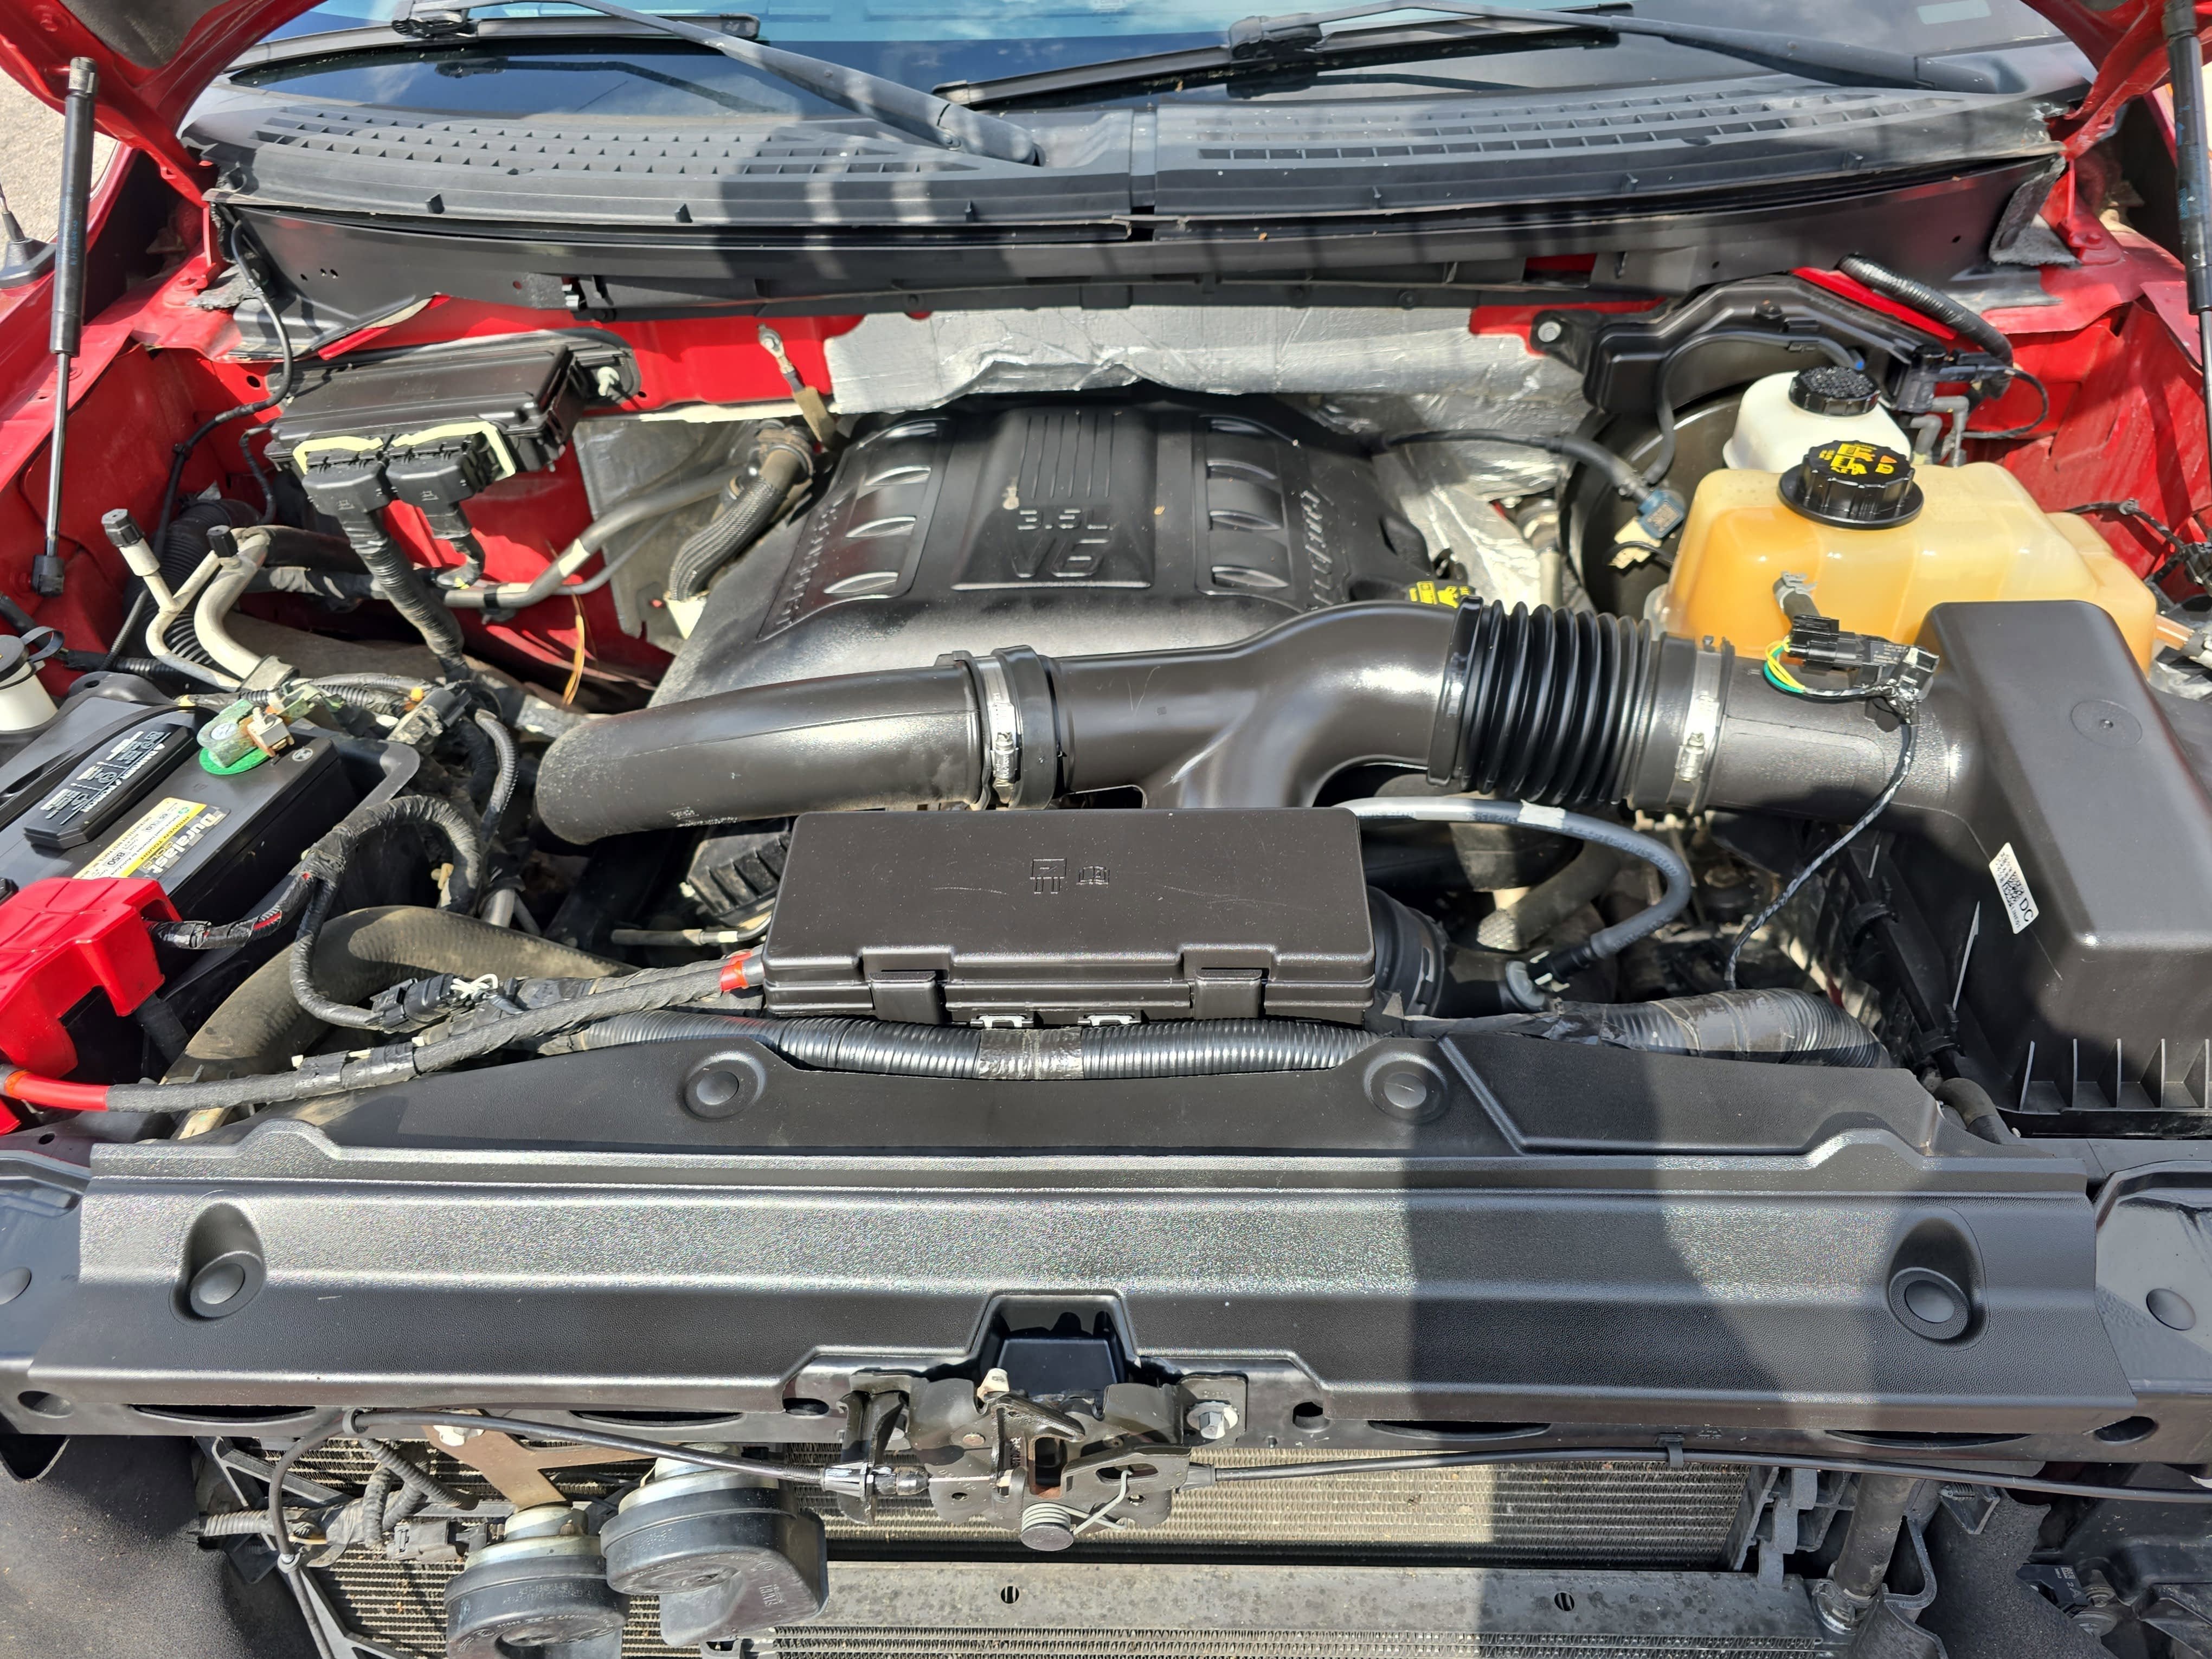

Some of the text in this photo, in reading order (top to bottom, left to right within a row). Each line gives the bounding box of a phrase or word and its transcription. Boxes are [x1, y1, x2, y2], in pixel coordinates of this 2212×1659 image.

[1010, 537, 1110, 578] V6
[163, 816, 190, 838] PROVEN
[140, 840, 163, 860] TOUGH
[143, 841, 173, 868] GOLD
[147, 812, 224, 873] Duralast
[106, 852, 126, 865] 850
[2020, 898, 2034, 922] DC
